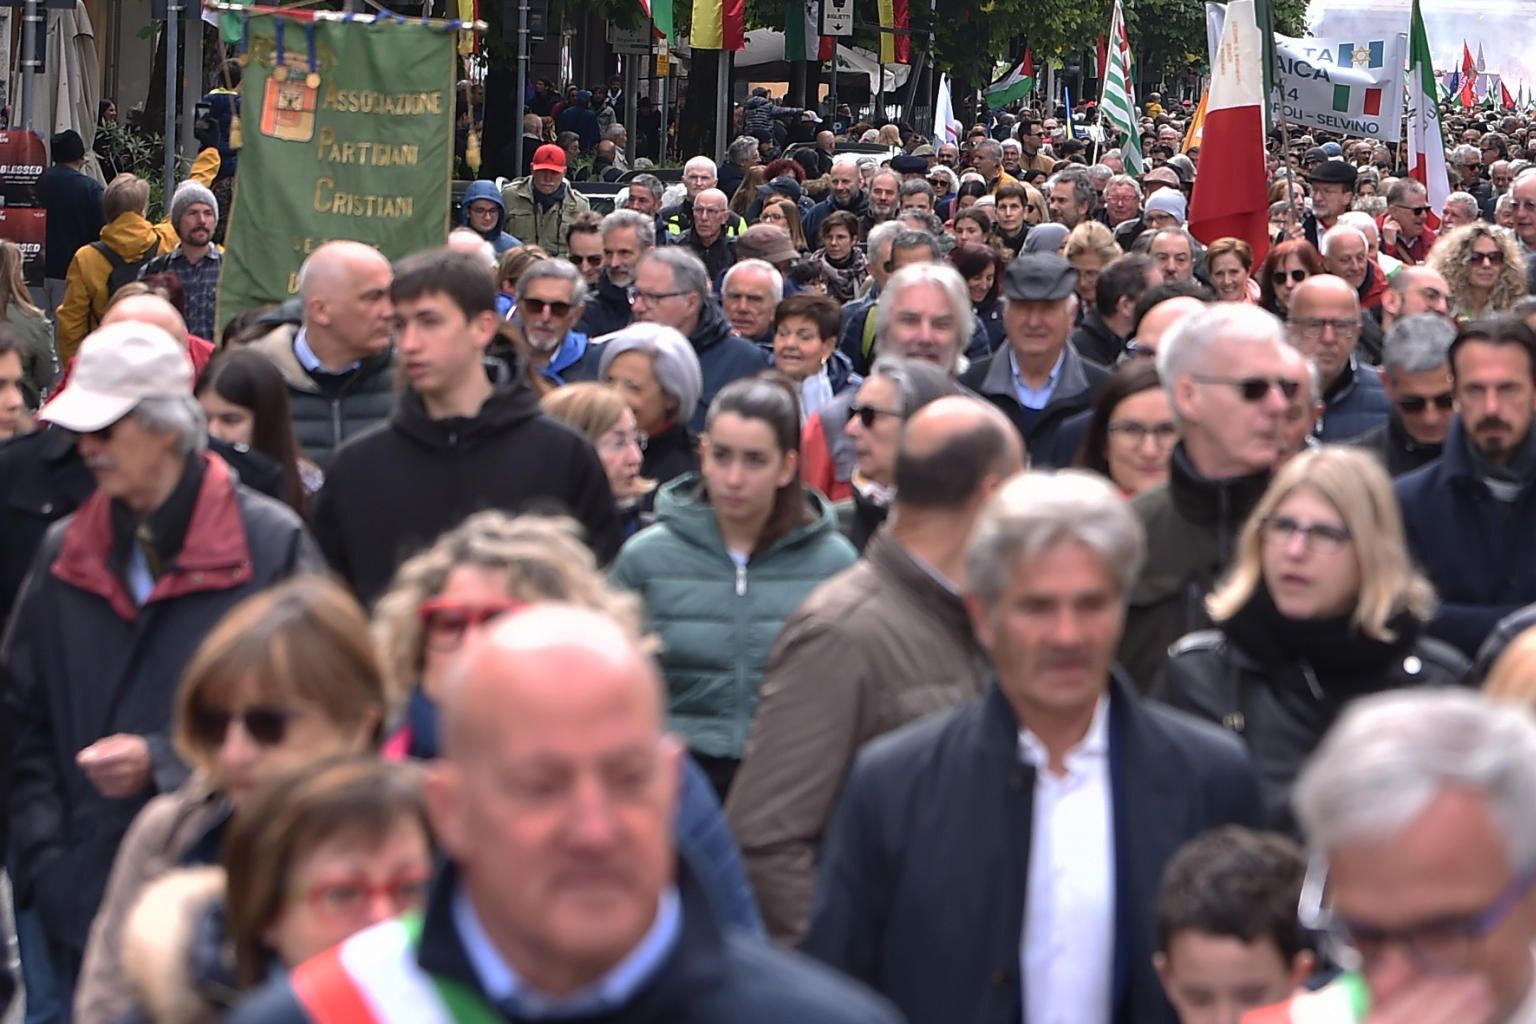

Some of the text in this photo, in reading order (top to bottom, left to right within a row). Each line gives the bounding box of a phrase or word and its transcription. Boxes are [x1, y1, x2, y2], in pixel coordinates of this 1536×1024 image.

[1276, 55, 1331, 83] AICA
[1317, 113, 1380, 135] SELVINO
[318, 125, 419, 166] PARTIGIANI
[0, 164, 43, 175] BLESSED
[313, 176, 414, 218] CRISTIANI
